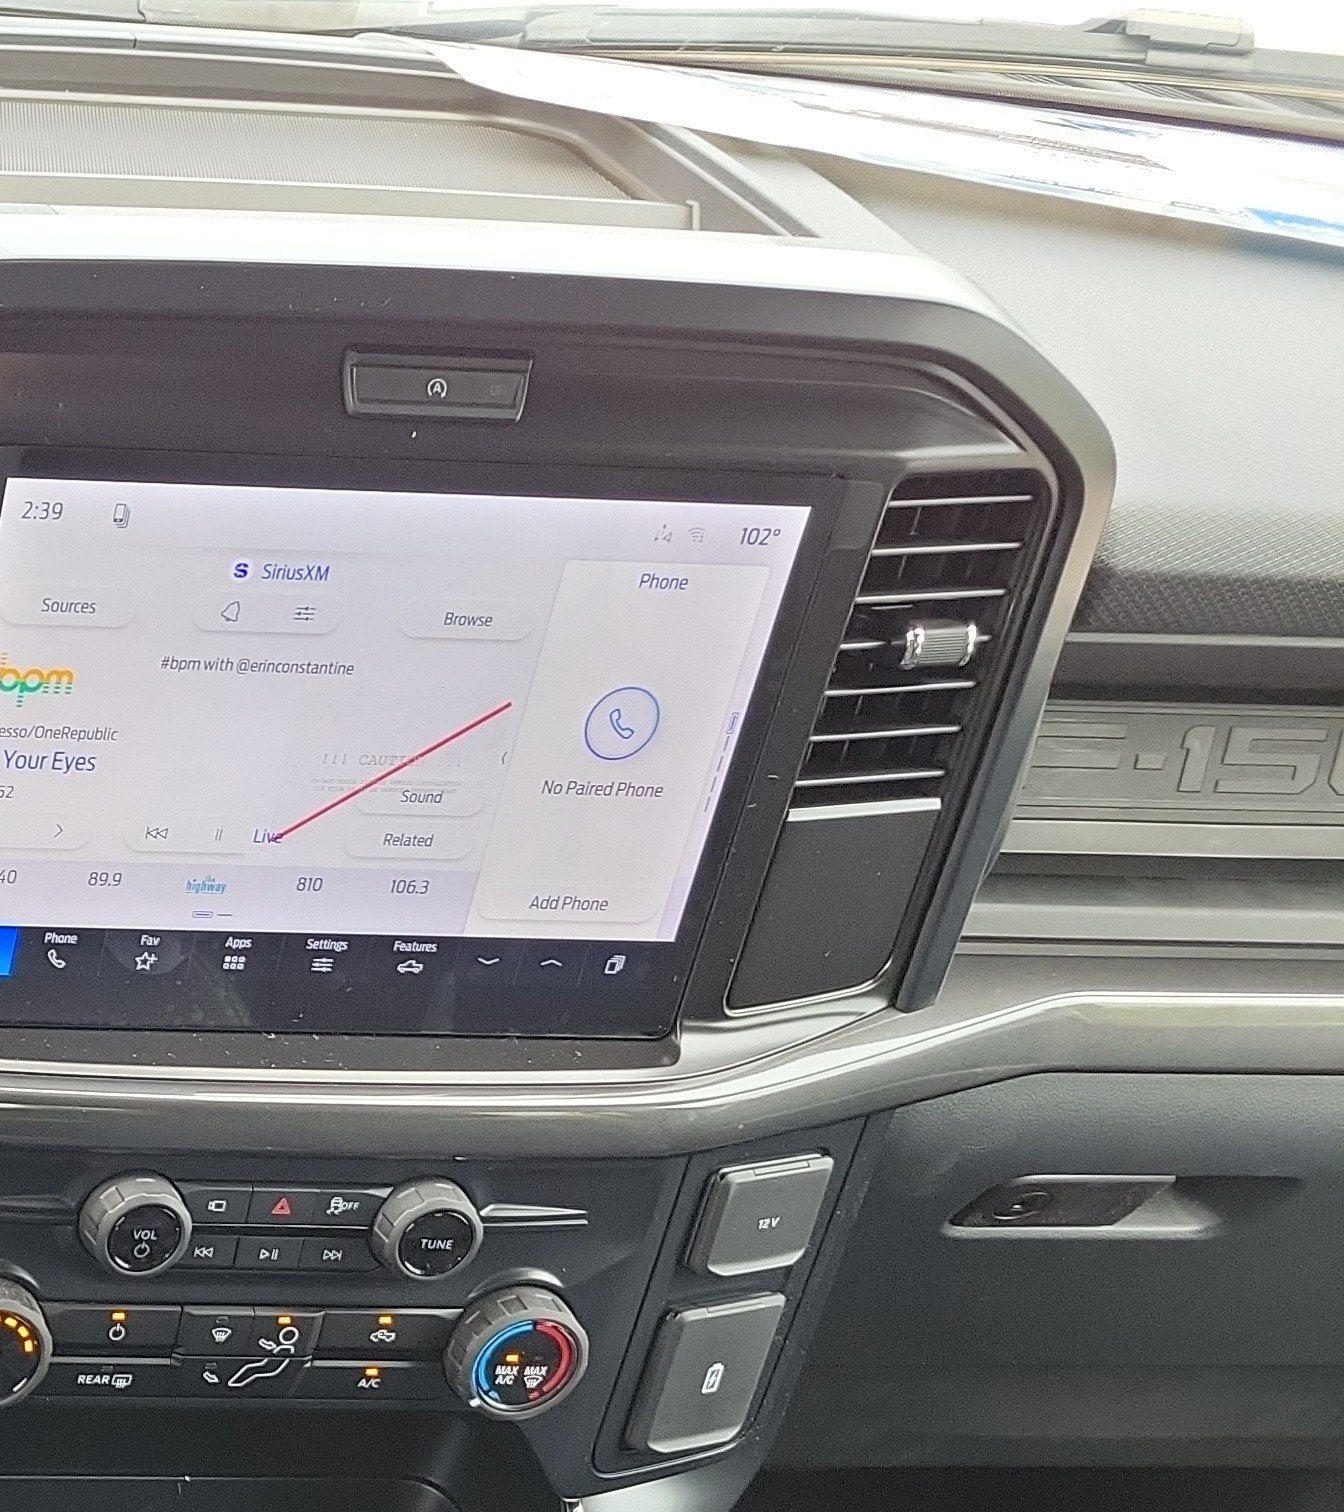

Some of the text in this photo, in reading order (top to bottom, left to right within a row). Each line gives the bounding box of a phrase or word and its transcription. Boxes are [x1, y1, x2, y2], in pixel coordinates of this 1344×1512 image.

[21, 501, 63, 520] 2:39
[740, 527, 781, 546] 102°
[261, 563, 330, 582] SiriusXM
[639, 573, 688, 590] Phone
[41, 598, 96, 614] Sources
[443, 612, 493, 628] Browse
[160, 655, 354, 677] #bpm with @erinconstantine
[3, 750, 47, 770] Your
[51, 751, 96, 774] Eyes
[358, 753, 426, 767] CAUTI
[1028, 719, 1344, 796] F-15
[541, 779, 663, 798] No Paired Phone
[400, 790, 444, 805] Sound
[253, 828, 283, 844] Live
[383, 833, 434, 848] Related
[87, 871, 122, 888] 89.9
[296, 877, 323, 892] 810
[390, 879, 430, 895] 106.3
[529, 895, 608, 912] Add Phone
[44, 931, 78, 945] Phone
[140, 934, 160, 946] Fav
[225, 936, 251, 950] Apps
[305, 938, 349, 952] Settings
[393, 940, 438, 953] Features
[342, 1201, 360, 1211] OFF
[132, 1229, 158, 1241] VOL
[420, 1239, 454, 1250] TUNE
[495, 1365, 519, 1375] MAX
[523, 1366, 548, 1376] MAX
[77, 1373, 110, 1385] REAR
[357, 1377, 380, 1389] A/C
[494, 1375, 514, 1385] A/C
